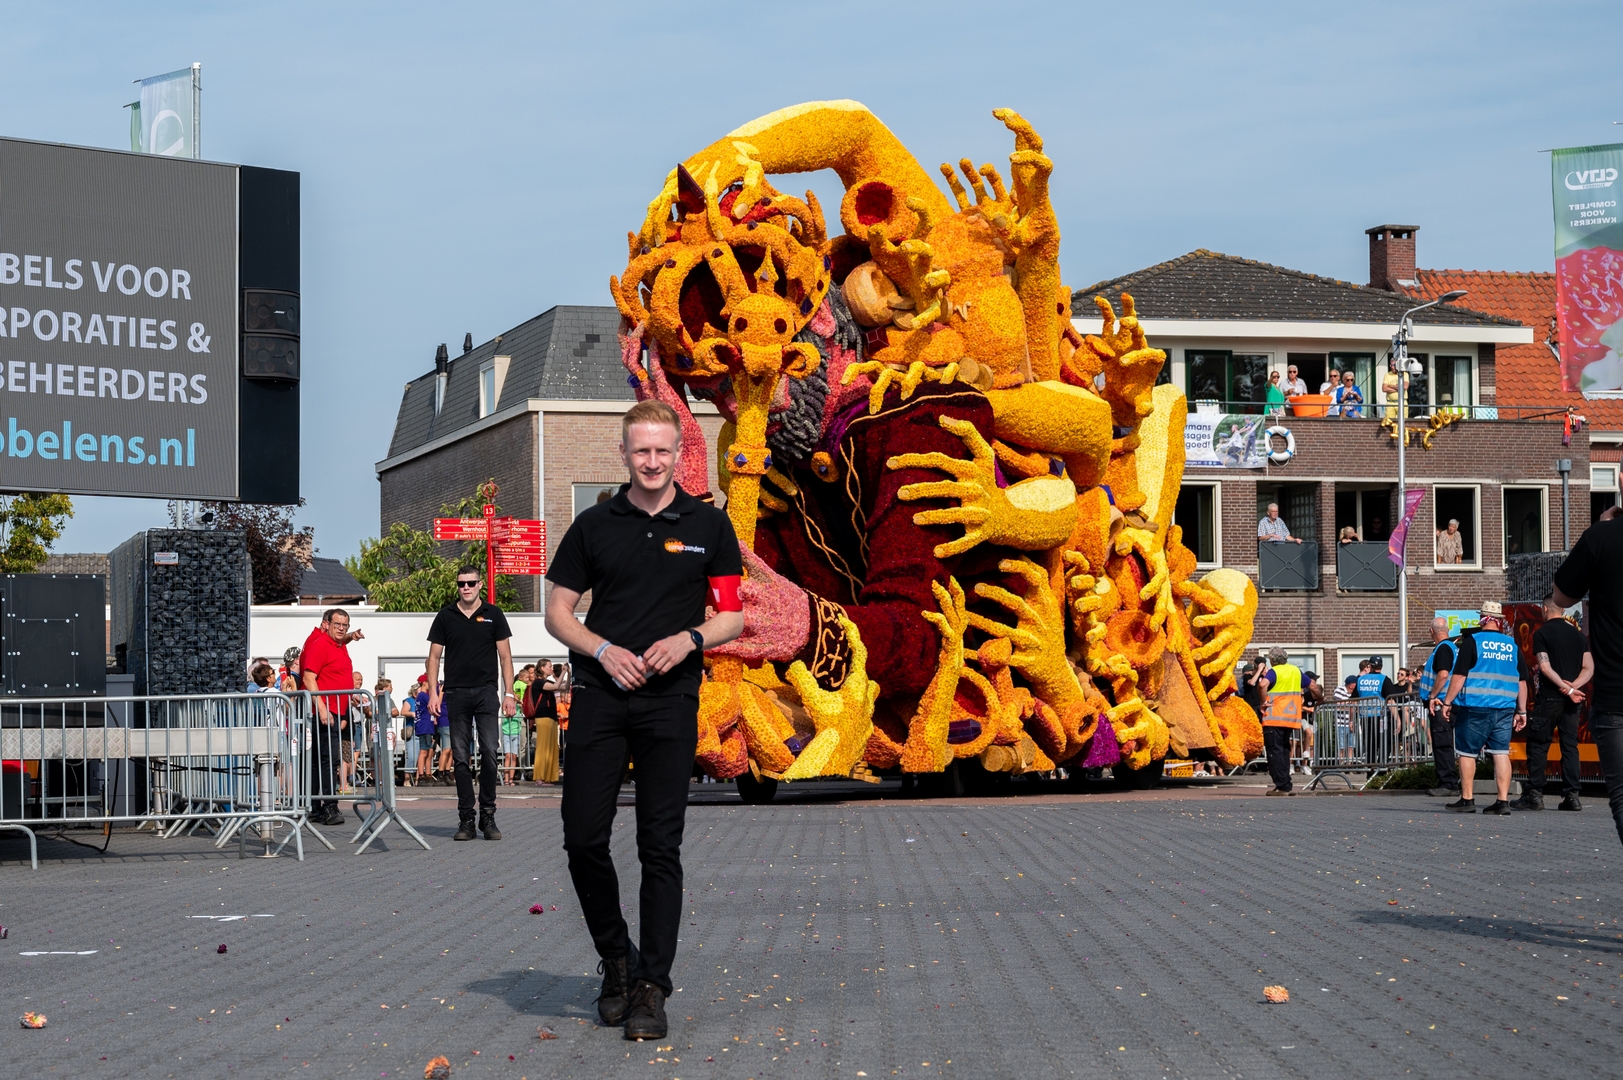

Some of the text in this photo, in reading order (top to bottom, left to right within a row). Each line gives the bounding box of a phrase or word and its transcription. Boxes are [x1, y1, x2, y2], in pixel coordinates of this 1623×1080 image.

[92, 260, 192, 300] VOOR
[186, 322, 212, 354] &
[0, 360, 208, 404] EHEERDERS
[0, 418, 195, 467] belens.nl
[1186, 442, 1210, 450] goed!
[684, 545, 705, 554] zundert
[1482, 640, 1513, 652] corso
